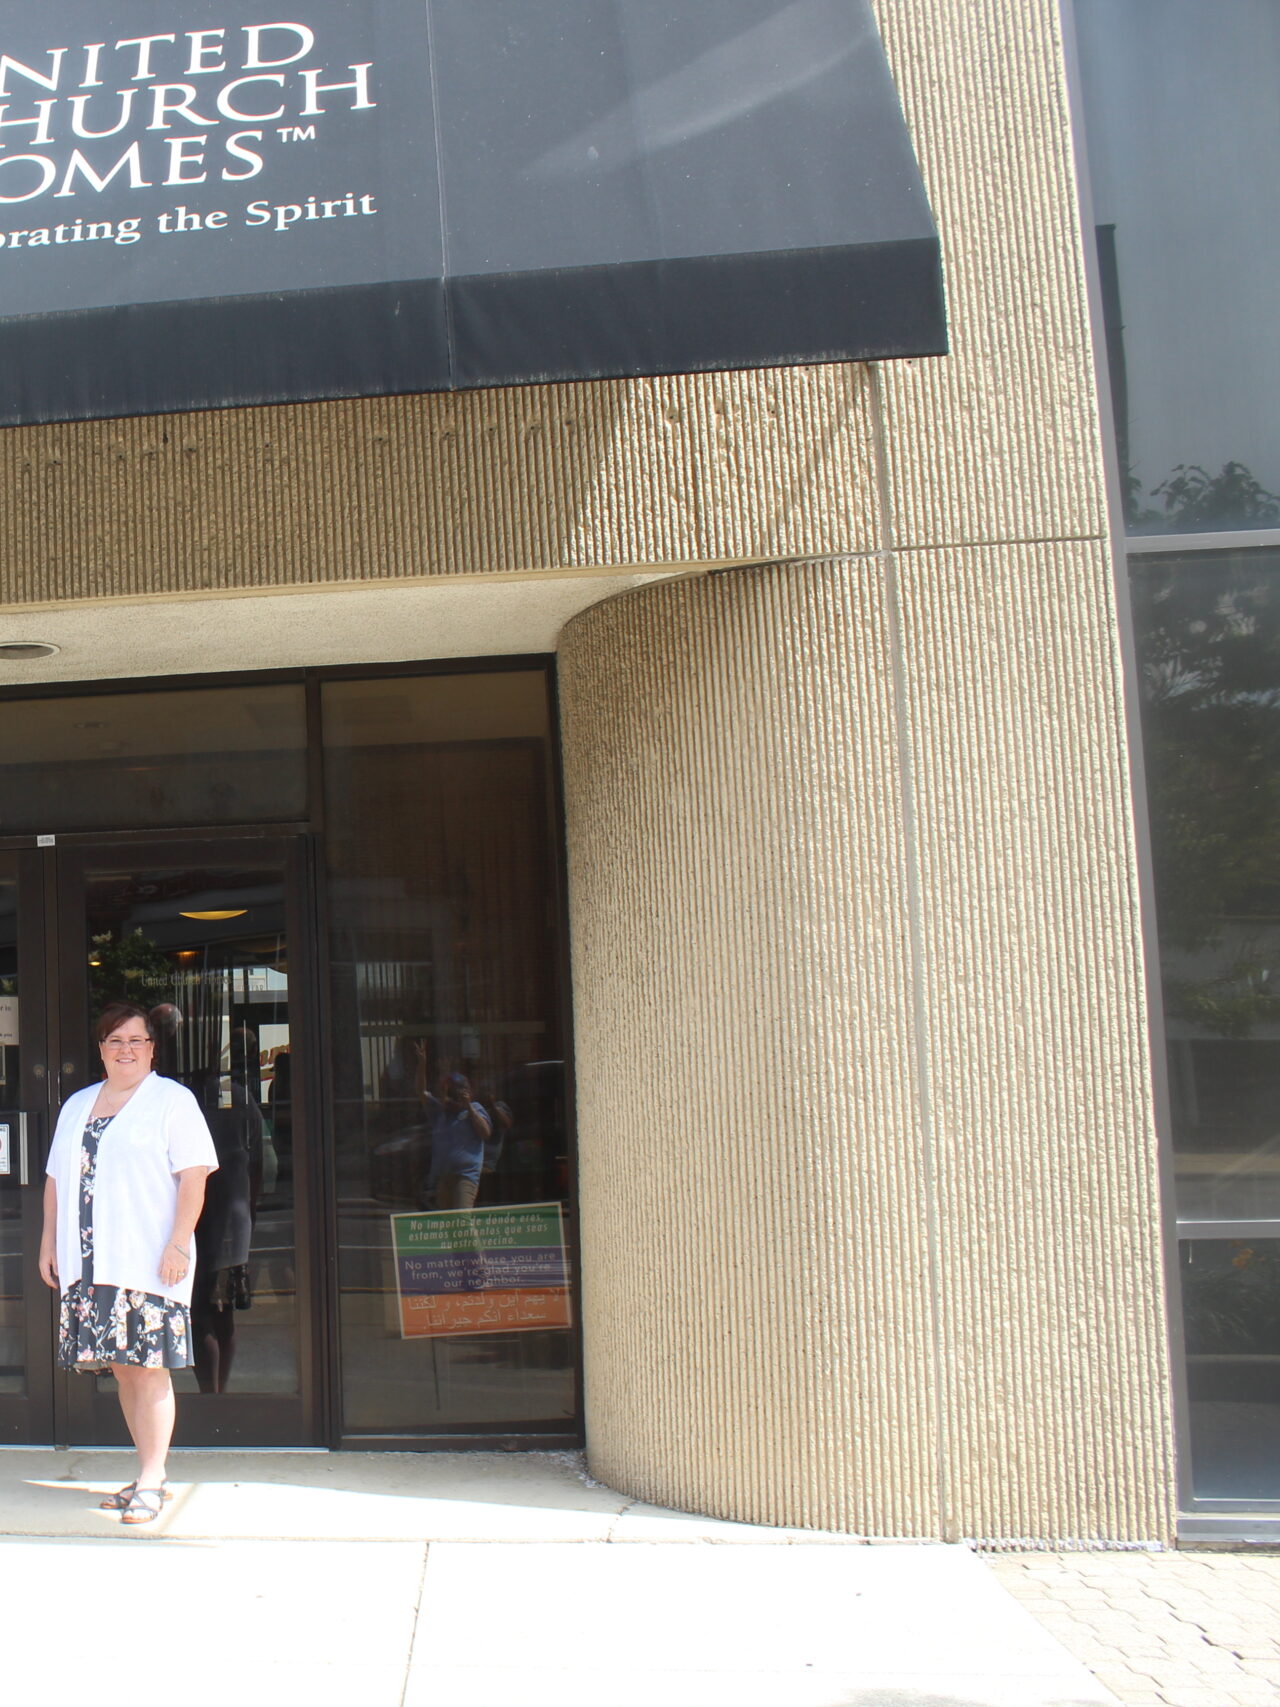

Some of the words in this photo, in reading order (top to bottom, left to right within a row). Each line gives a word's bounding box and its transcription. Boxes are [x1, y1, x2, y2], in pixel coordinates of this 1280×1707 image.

[157, 205, 228, 234] the
[245, 192, 377, 232] Spirit
[410, 1220, 423, 1231] No
[427, 1217, 466, 1230] importa
[520, 1214, 544, 1225] eres,
[409, 1230, 448, 1242] estamos
[504, 1226, 522, 1237] que
[527, 1223, 548, 1233] seas
[481, 1235, 517, 1246] vecino.
[405, 1260, 423, 1271] No
[426, 1258, 465, 1270] matter
[471, 1255, 506, 1266] where
[511, 1255, 532, 1266] you
[536, 1252, 556, 1261] are
[411, 1271, 443, 1281] from,
[447, 1267, 481, 1278] we're
[483, 1264, 510, 1276] glad
[514, 1262, 551, 1275] you're
[443, 1279, 462, 1289] our
